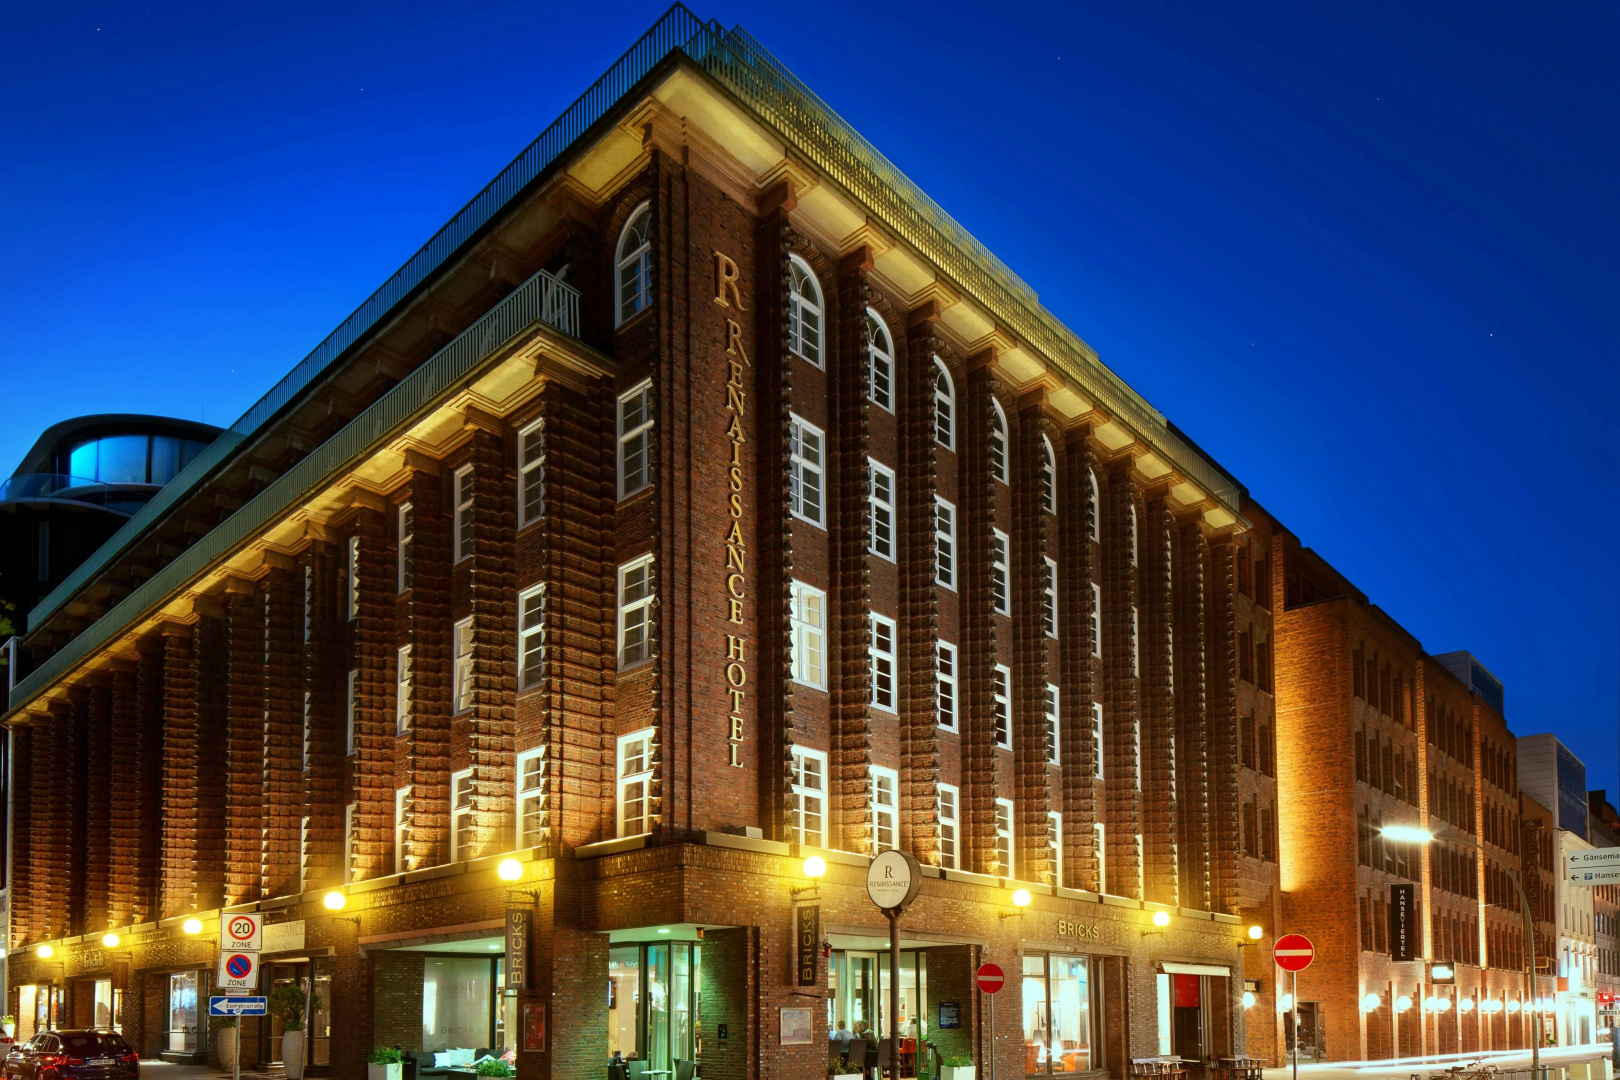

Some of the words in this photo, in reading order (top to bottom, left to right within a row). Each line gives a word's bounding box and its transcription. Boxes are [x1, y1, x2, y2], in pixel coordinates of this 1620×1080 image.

[714, 250, 749, 311] R
[726, 318, 752, 625] RENAISSANCE
[726, 634, 746, 769] HOTEL
[885, 866, 894, 878] R
[234, 922, 250, 934] 20
[511, 912, 523, 984] BRICKS
[802, 909, 812, 980] BRICKS
[1058, 920, 1099, 939] BRICKS
[440, 1026, 474, 1034] BRICKS
